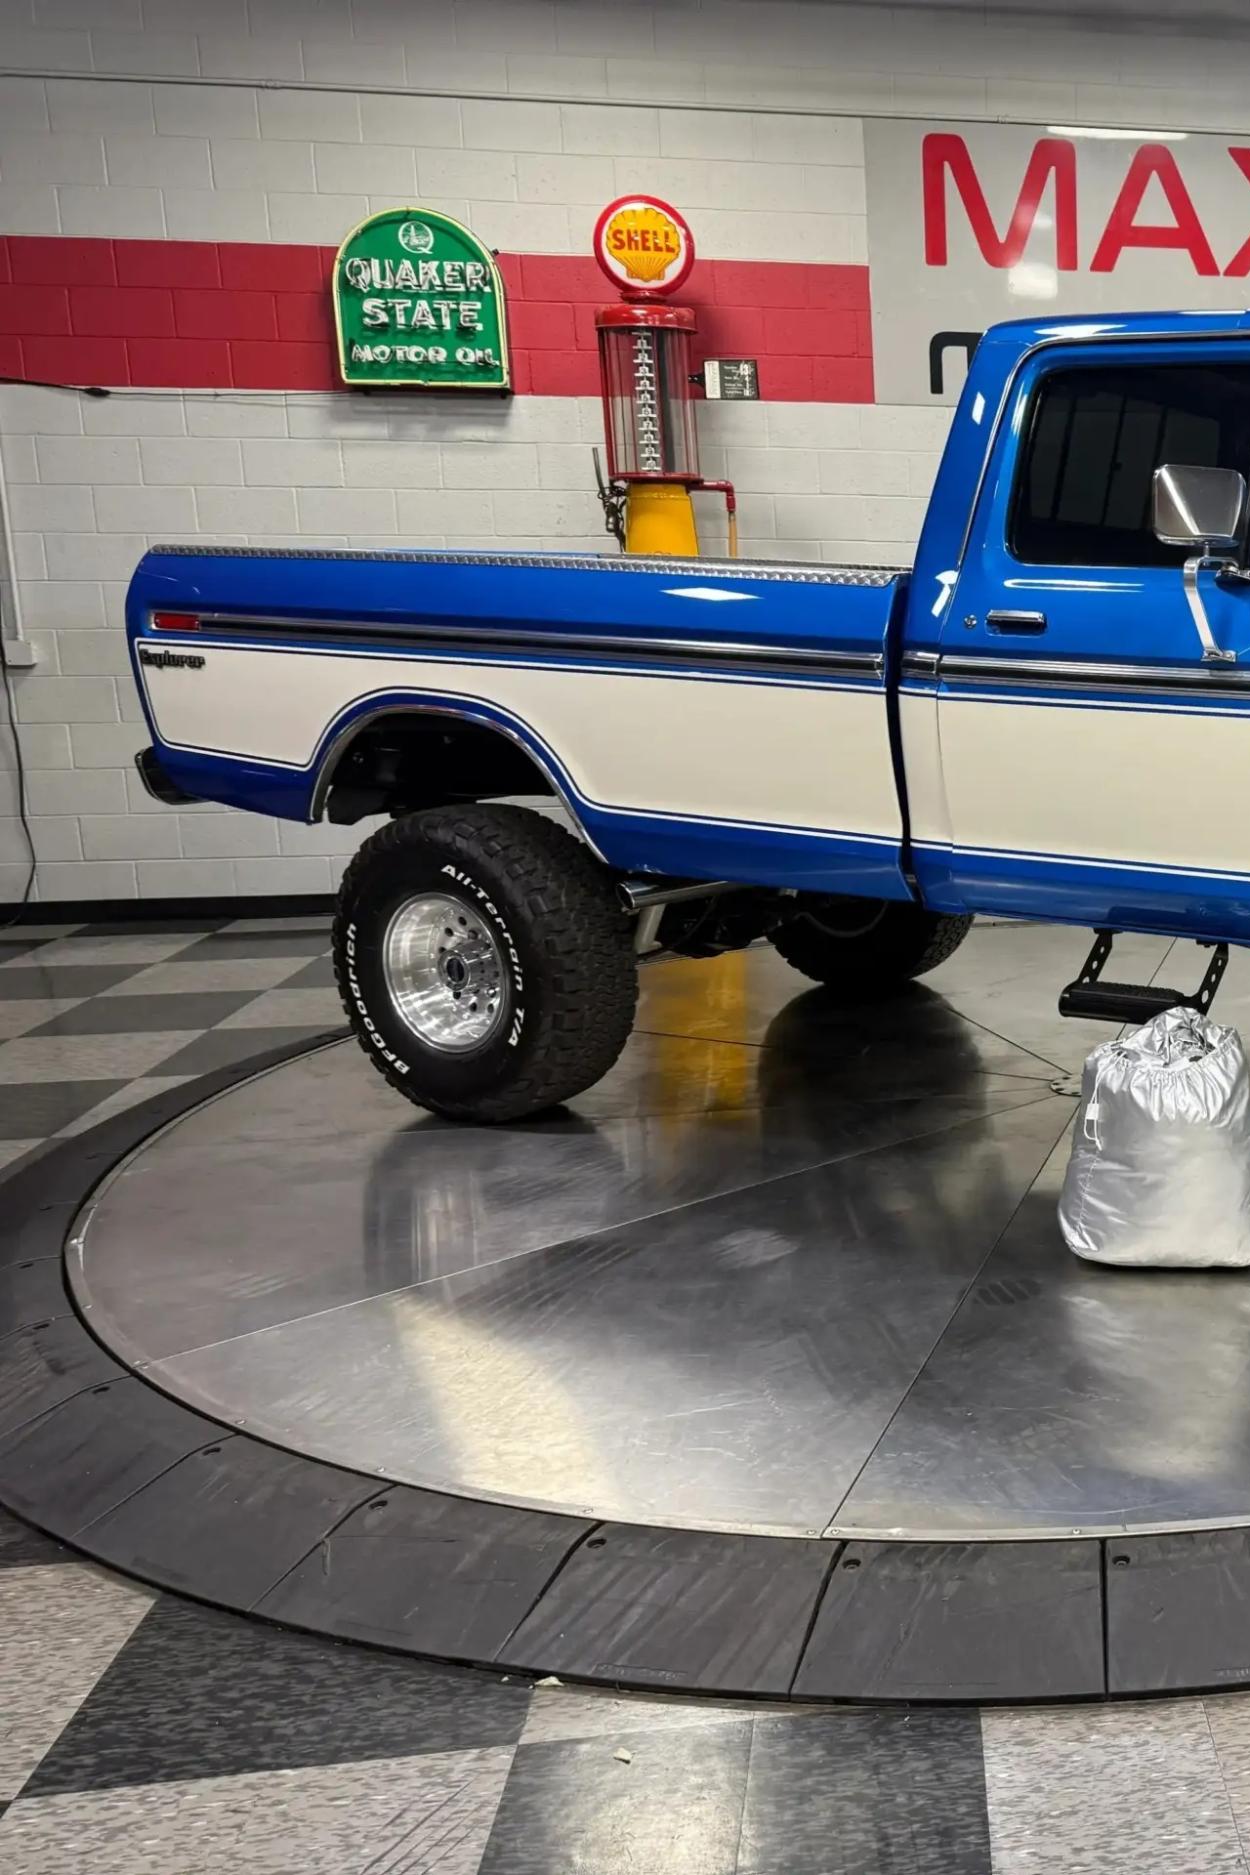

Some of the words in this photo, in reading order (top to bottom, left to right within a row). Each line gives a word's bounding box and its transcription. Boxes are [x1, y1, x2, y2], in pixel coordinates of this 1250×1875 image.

[612, 228, 675, 253] SHELL
[345, 257, 492, 293] QUAKER
[362, 298, 483, 331] STATE
[351, 344, 447, 364] MOTOR
[455, 346, 499, 366] OIL
[440, 864, 523, 991] All-Terrain
[507, 1007, 525, 1047] T/A
[346, 923, 411, 1075] BFGoodrich
